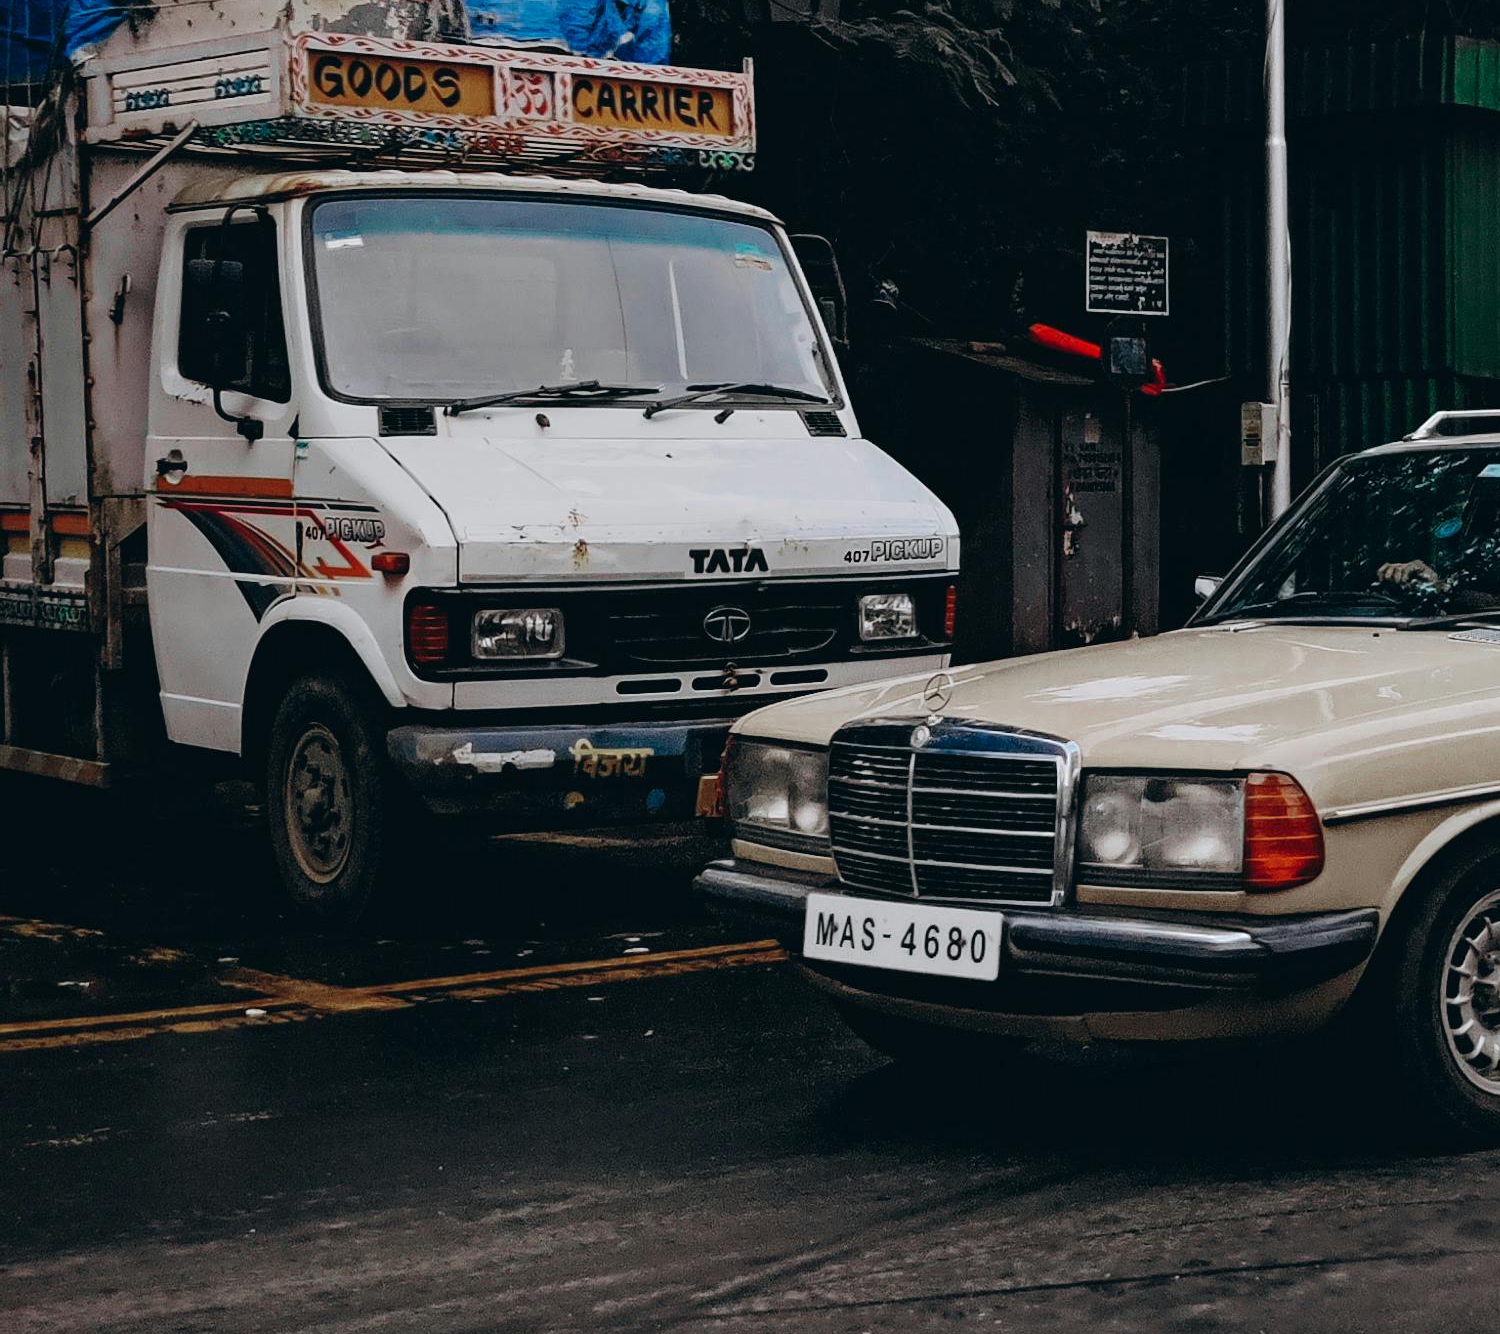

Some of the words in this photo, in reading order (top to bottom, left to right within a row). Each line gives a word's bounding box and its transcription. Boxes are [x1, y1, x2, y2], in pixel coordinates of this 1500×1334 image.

[314, 55, 462, 107] GOODS
[571, 78, 722, 131] CARRIER
[305, 526, 325, 541] 407
[324, 517, 386, 543] PICKUP
[688, 548, 769, 573] TATA
[844, 551, 870, 563] 407
[870, 538, 944, 562] PICKUP
